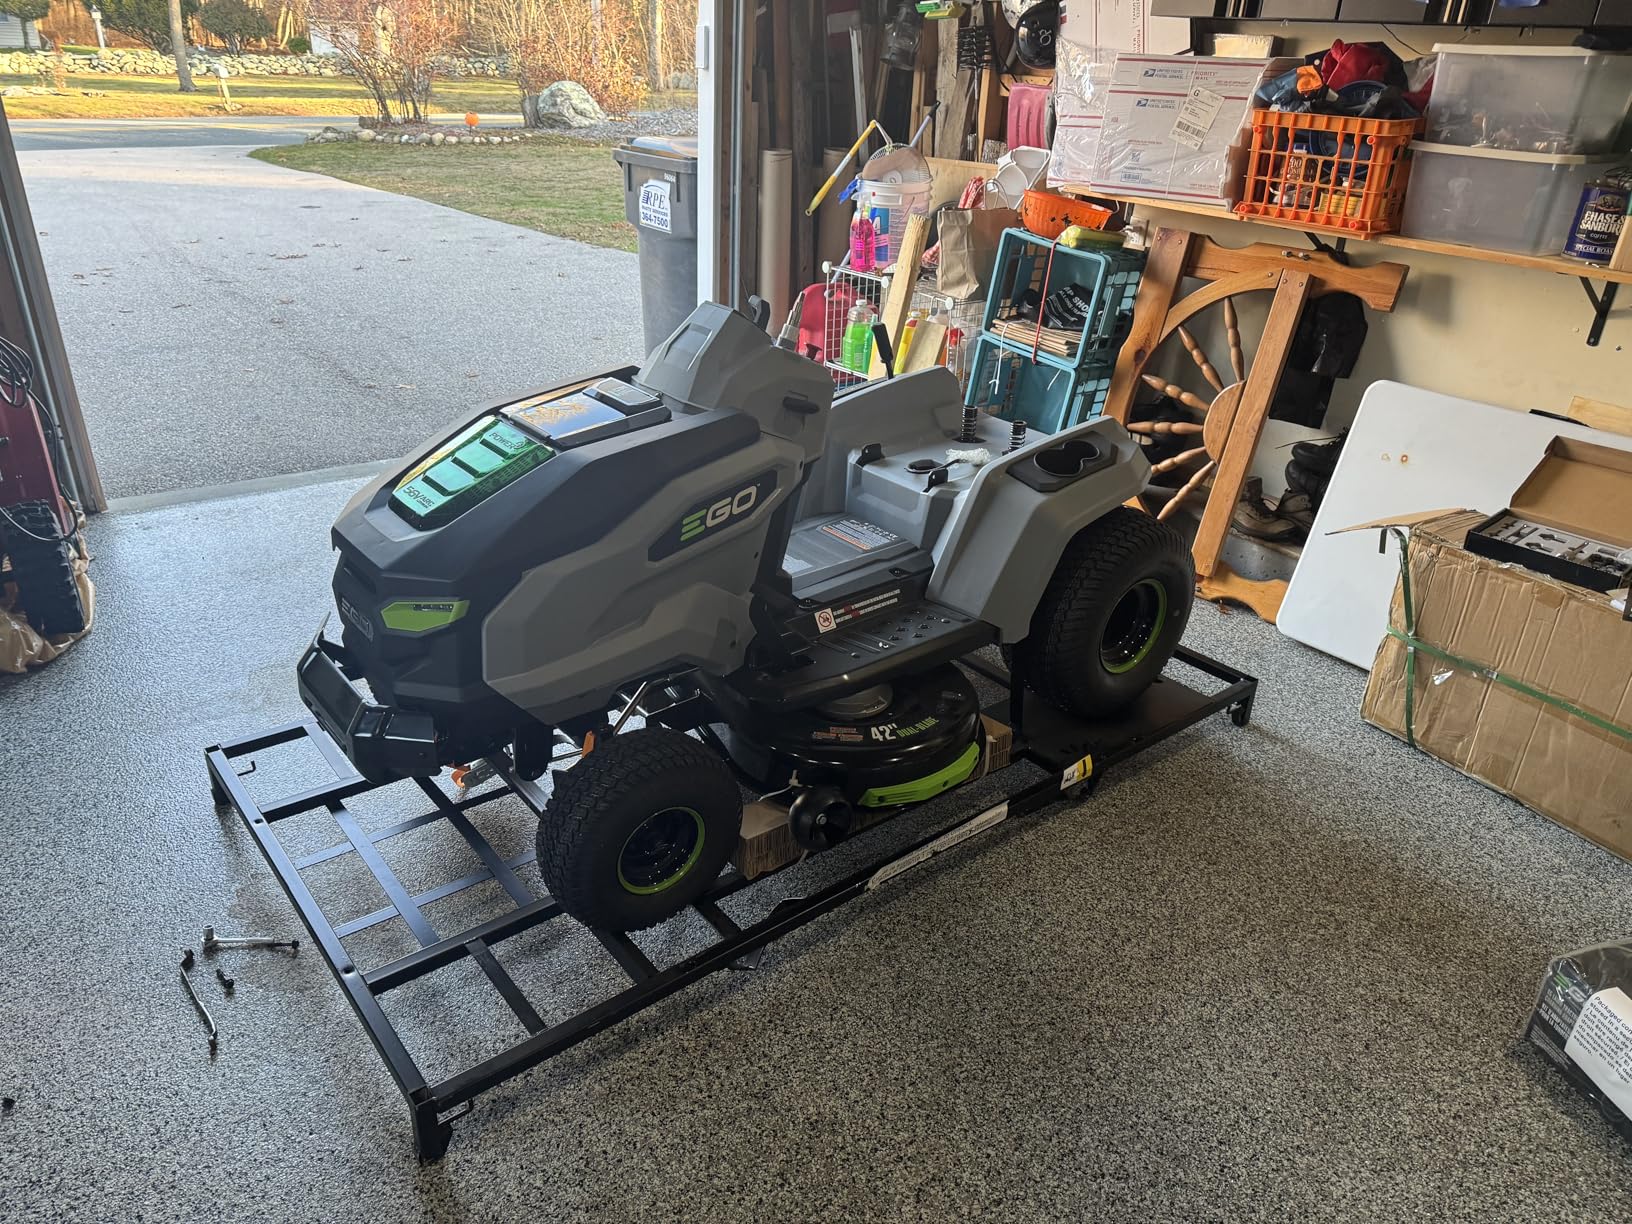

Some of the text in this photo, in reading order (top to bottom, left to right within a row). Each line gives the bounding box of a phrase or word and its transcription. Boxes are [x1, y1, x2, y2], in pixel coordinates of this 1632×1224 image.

[1193, 89, 1201, 97] G
[642, 190, 666, 210] RPE
[642, 211, 668, 228] 364-7500
[1584, 210, 1618, 224] CHASE
[1574, 243, 1596, 253] SPECIAL
[403, 486, 436, 507] 56V ARC
[681, 485, 758, 541] EGO
[870, 723, 898, 741] 42"
[1590, 1002, 1608, 1020] stored
[1594, 996, 1622, 1024] Packaged
[1597, 1018, 1620, 1041] contenu
